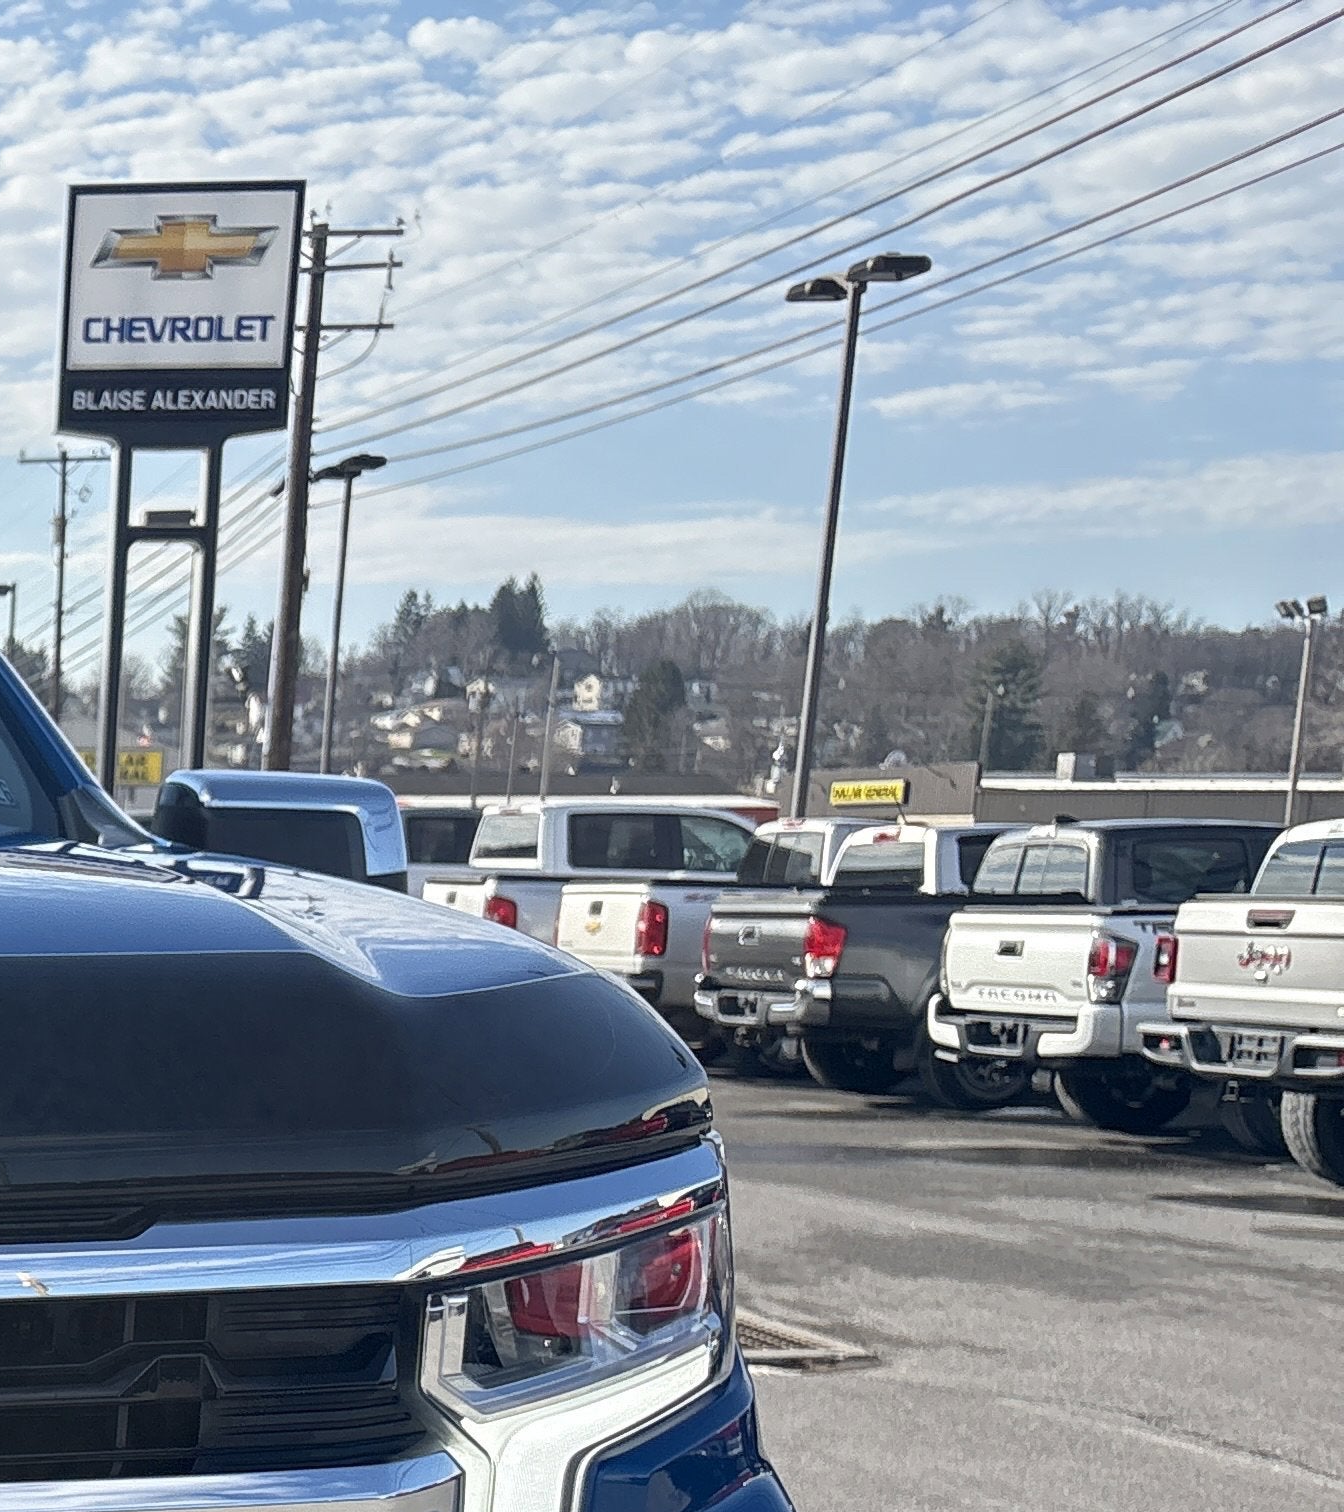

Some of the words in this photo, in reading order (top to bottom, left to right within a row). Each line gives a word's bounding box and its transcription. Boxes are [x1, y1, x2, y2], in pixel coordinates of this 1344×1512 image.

[83, 314, 274, 343] CHEVROLET
[72, 389, 147, 411] BLAISE
[150, 388, 277, 411] ALEXANDER
